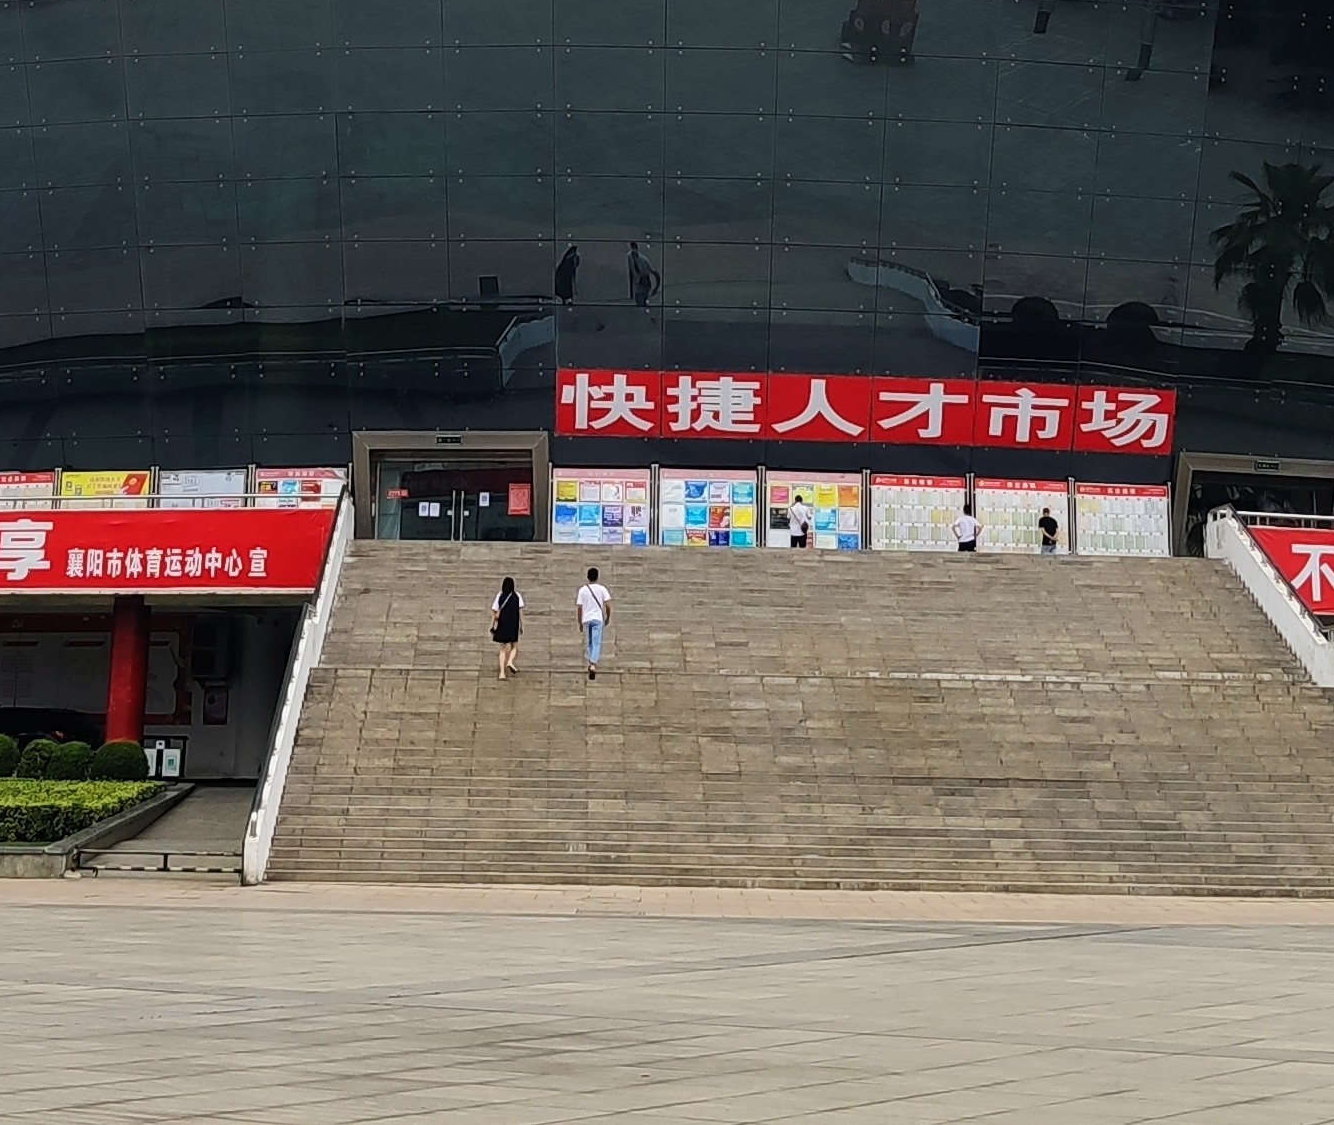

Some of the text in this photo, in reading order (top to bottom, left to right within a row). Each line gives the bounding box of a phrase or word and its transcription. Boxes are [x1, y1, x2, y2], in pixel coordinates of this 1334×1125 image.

[561, 373, 1168, 448] 快捷人才市场
